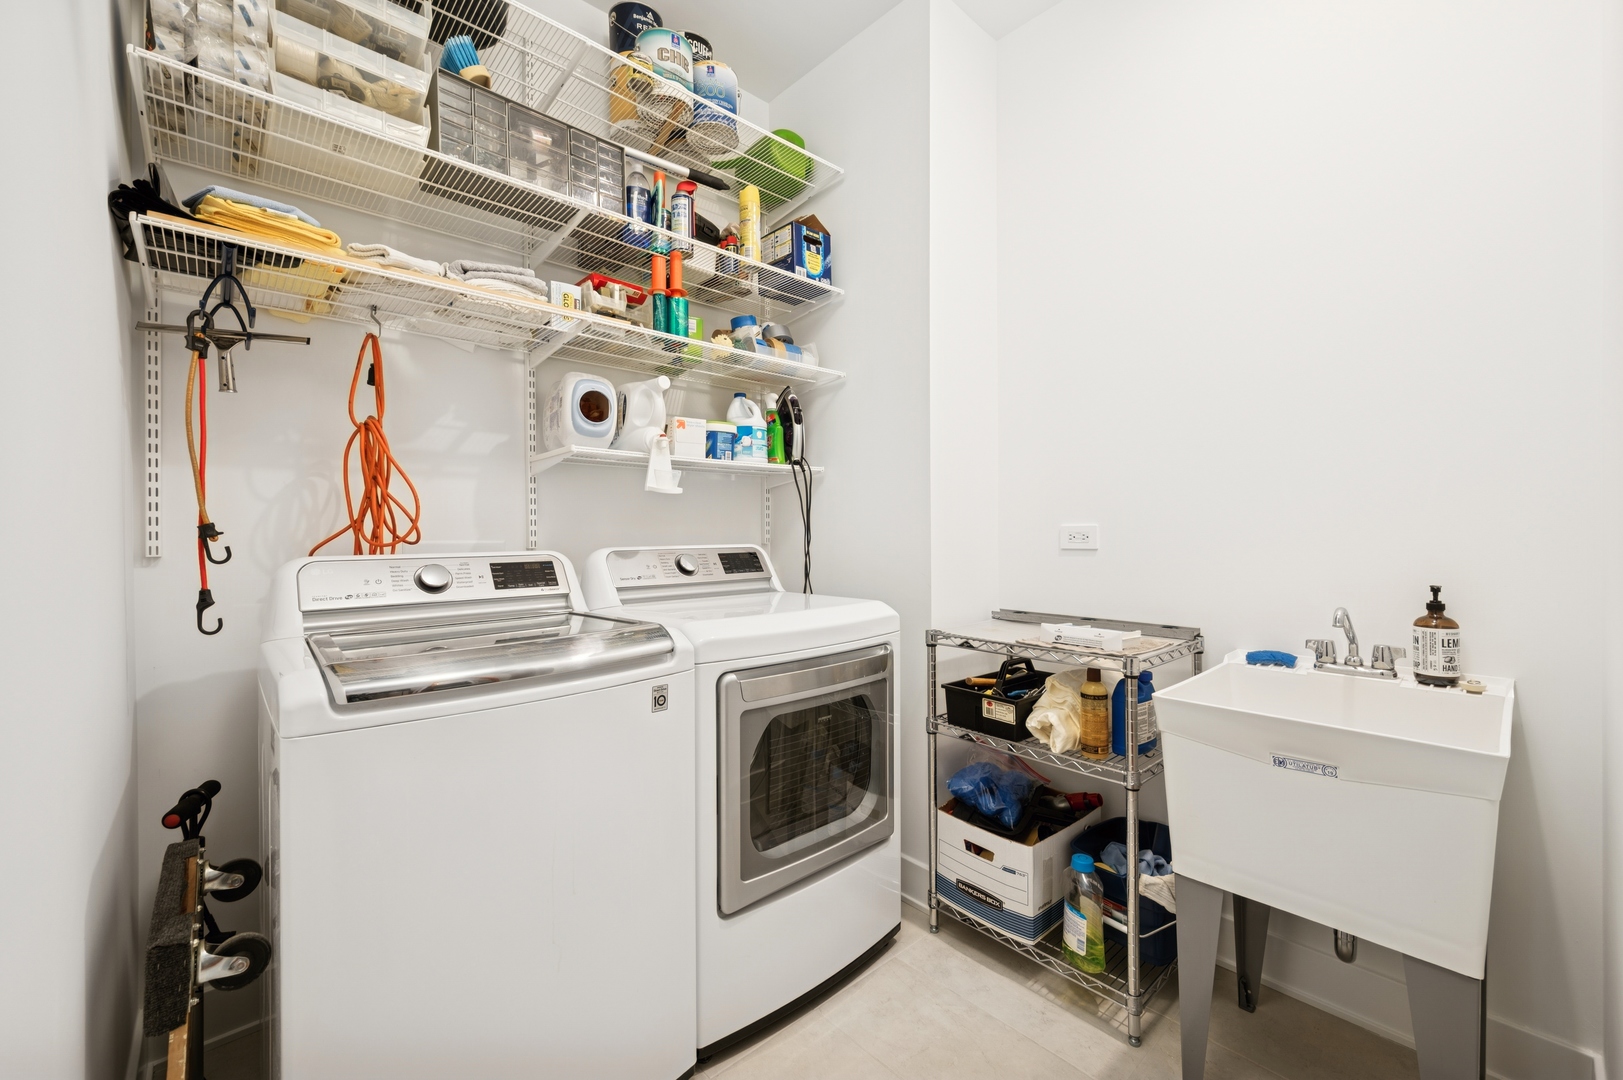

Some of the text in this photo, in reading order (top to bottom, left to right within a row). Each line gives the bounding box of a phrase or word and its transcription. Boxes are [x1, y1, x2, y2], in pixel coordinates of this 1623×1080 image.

[696, 83, 726, 98] 200
[653, 694, 667, 708] 10
[958, 882, 1001, 908] BANKERS BOX
